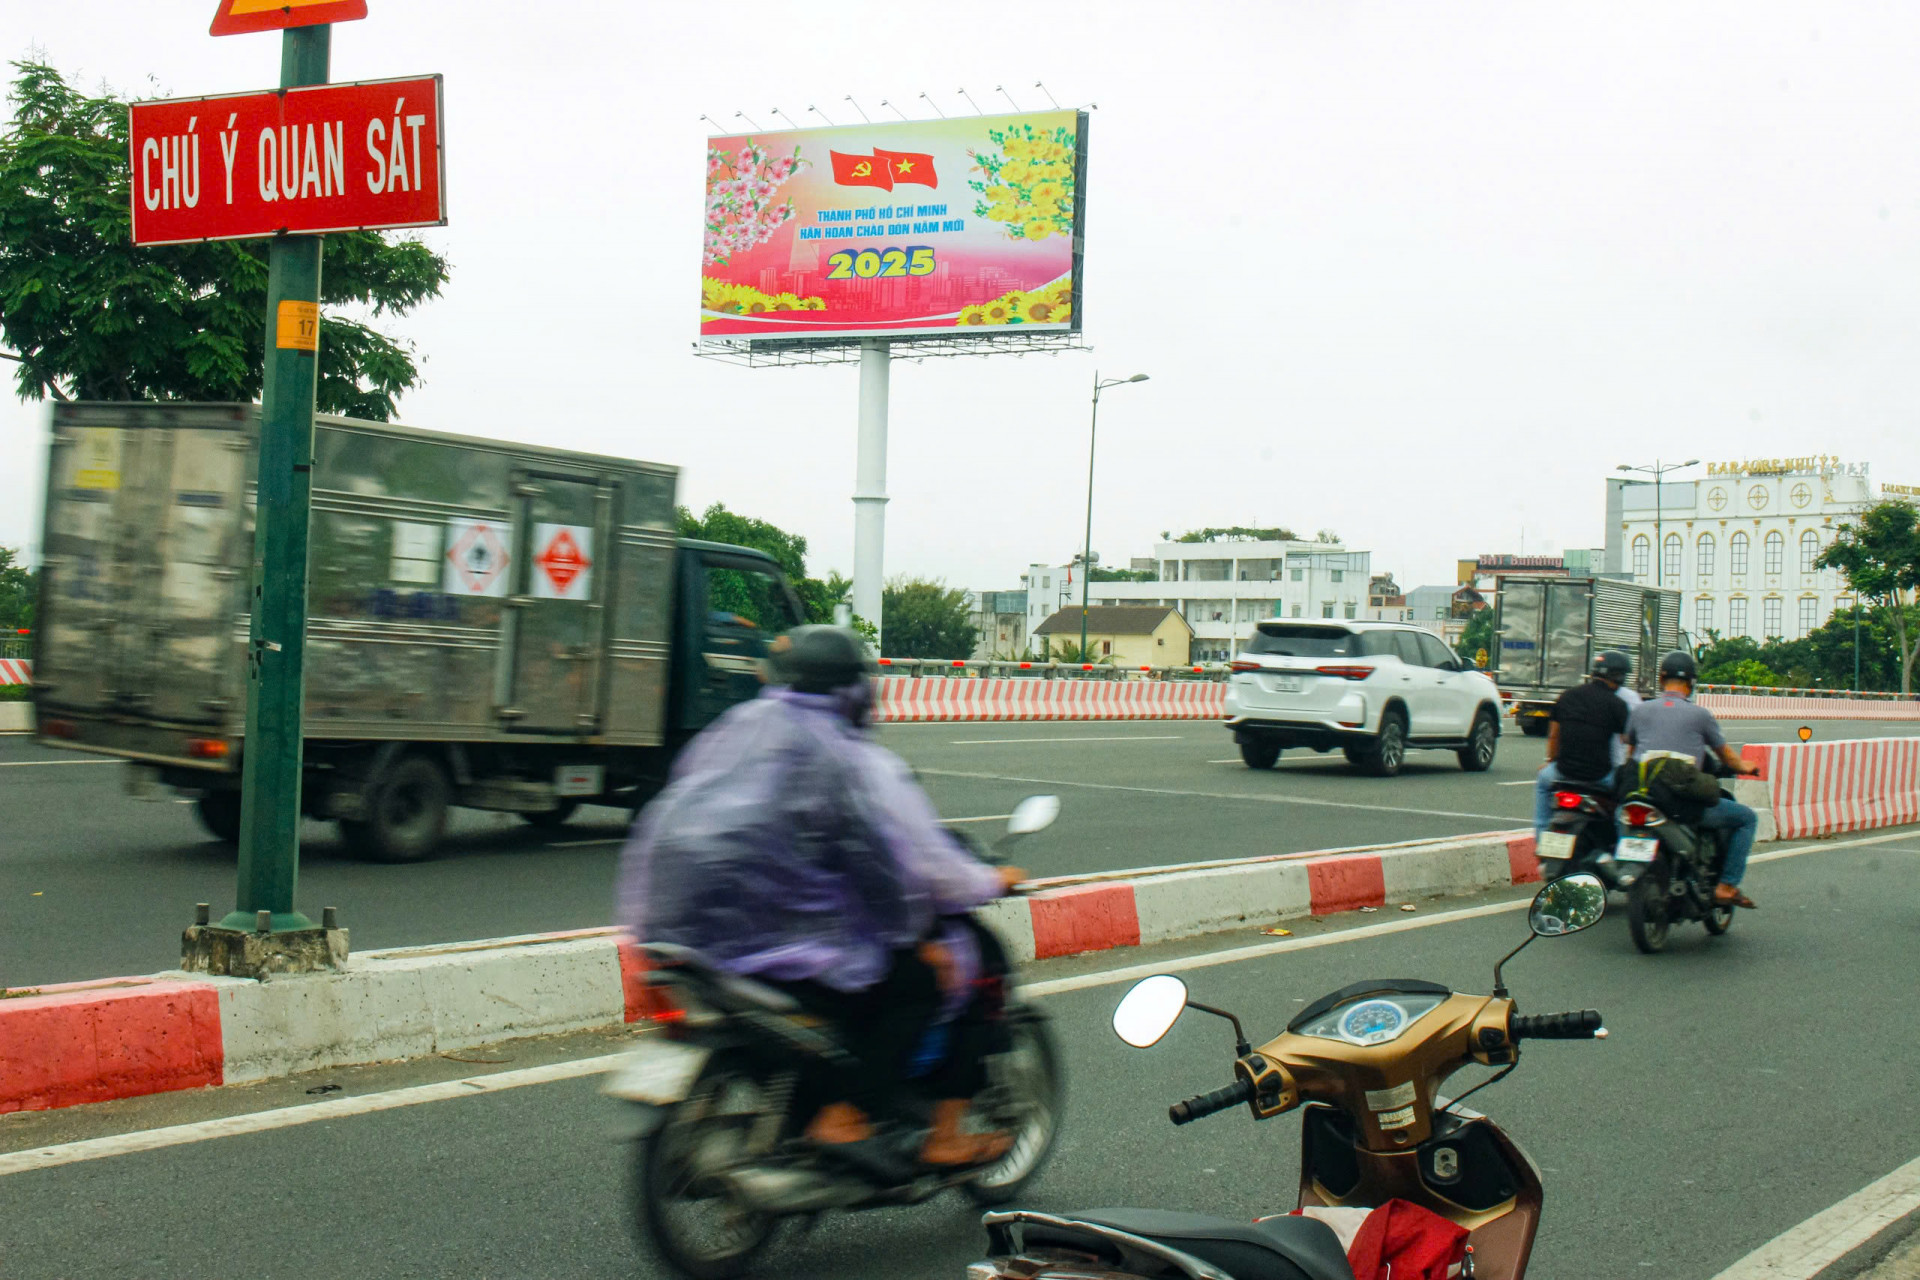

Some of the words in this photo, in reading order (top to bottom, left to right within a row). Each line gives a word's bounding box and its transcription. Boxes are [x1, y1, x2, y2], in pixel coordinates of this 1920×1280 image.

[142, 116, 200, 211] CHÚ
[219, 113, 239, 205] Ý
[258, 120, 345, 202] QUAN
[366, 97, 426, 194] SÁT
[817, 208, 852, 222] THÀNH
[855, 205, 876, 221] PHỐ
[896, 204, 914, 218] CHÍ
[917, 204, 947, 217] MINH
[825, 226, 853, 238] HOAN
[856, 223, 884, 237] CHÀO
[825, 245, 937, 280] 2025
[299, 319, 314, 337] 17
[1511, 555, 1563, 568] Building
